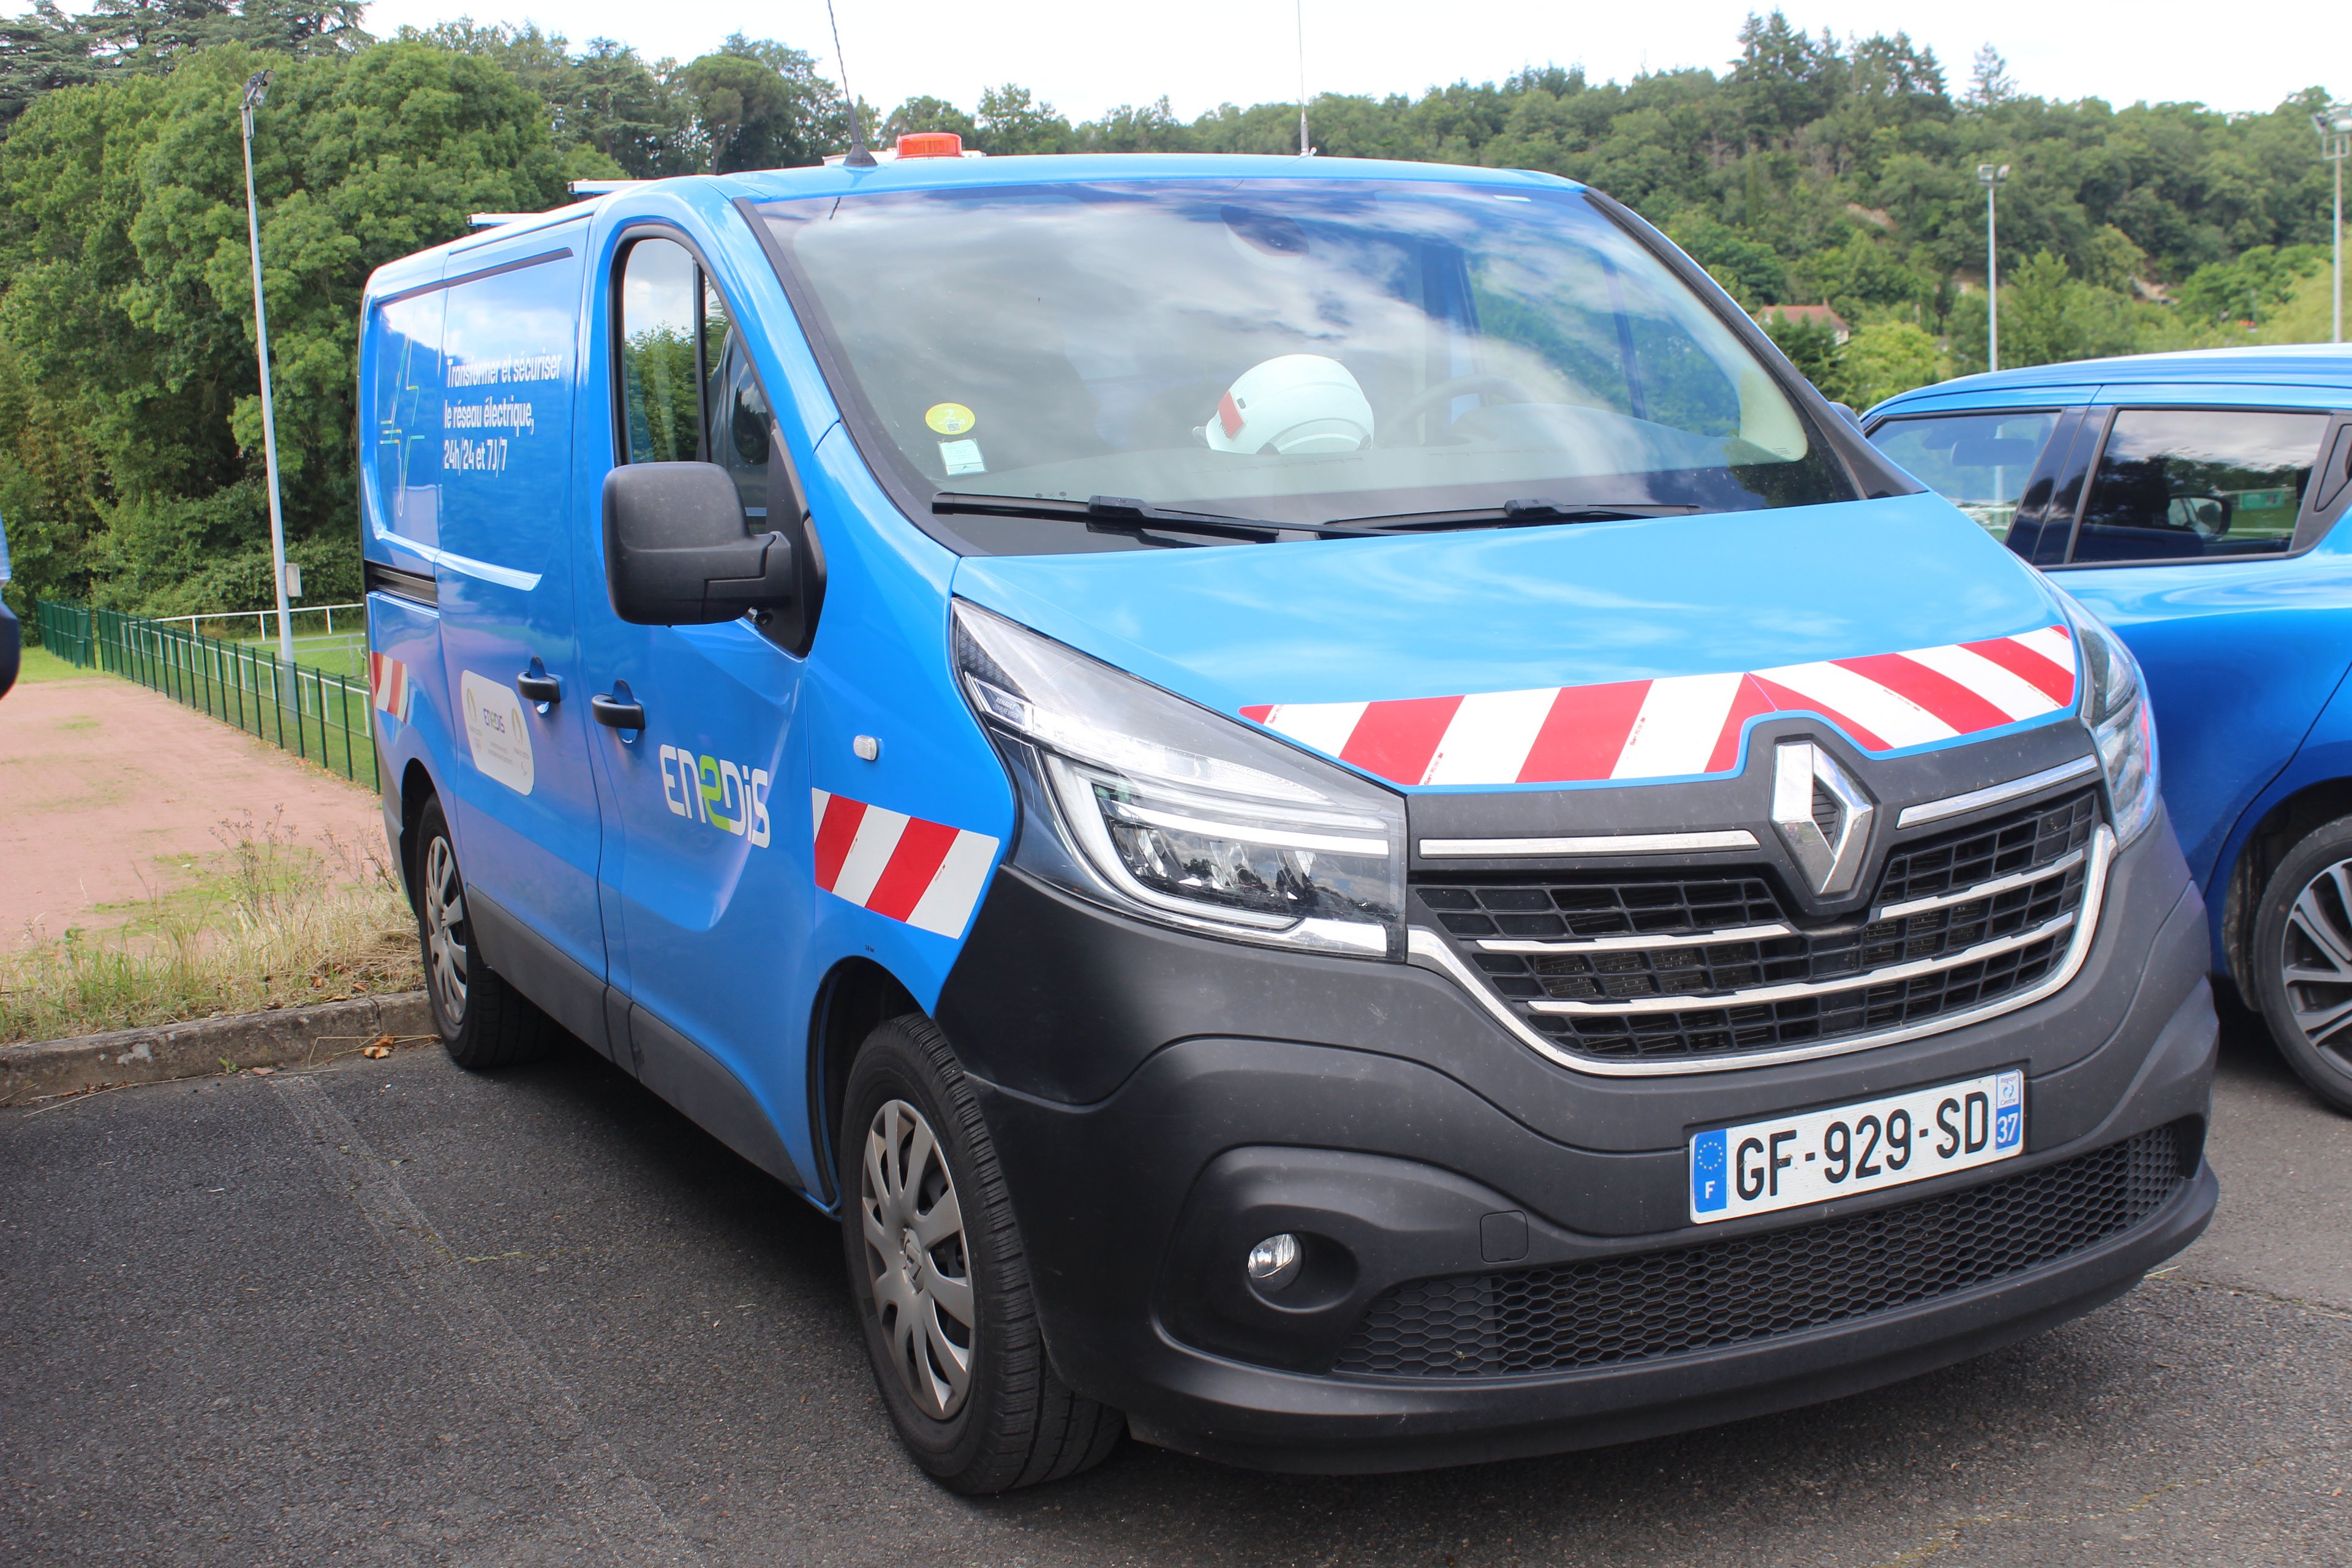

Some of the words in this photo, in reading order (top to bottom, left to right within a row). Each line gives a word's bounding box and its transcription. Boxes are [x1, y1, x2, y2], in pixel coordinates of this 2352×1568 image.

[447, 355, 501, 388] Transformer
[501, 353, 512, 384] et
[513, 347, 563, 382] sécuriser
[444, 399, 452, 429] le
[453, 399, 482, 429] réseau
[483, 395, 534, 437] électrique,
[443, 437, 475, 477] 24h/24
[476, 442, 486, 470] et
[995, 697, 1015, 709] RENAULT
[1736, 1091, 1989, 1200] GF-929-SD
[1997, 1112, 2018, 1143] 37
[1705, 1180, 1715, 1199] F
